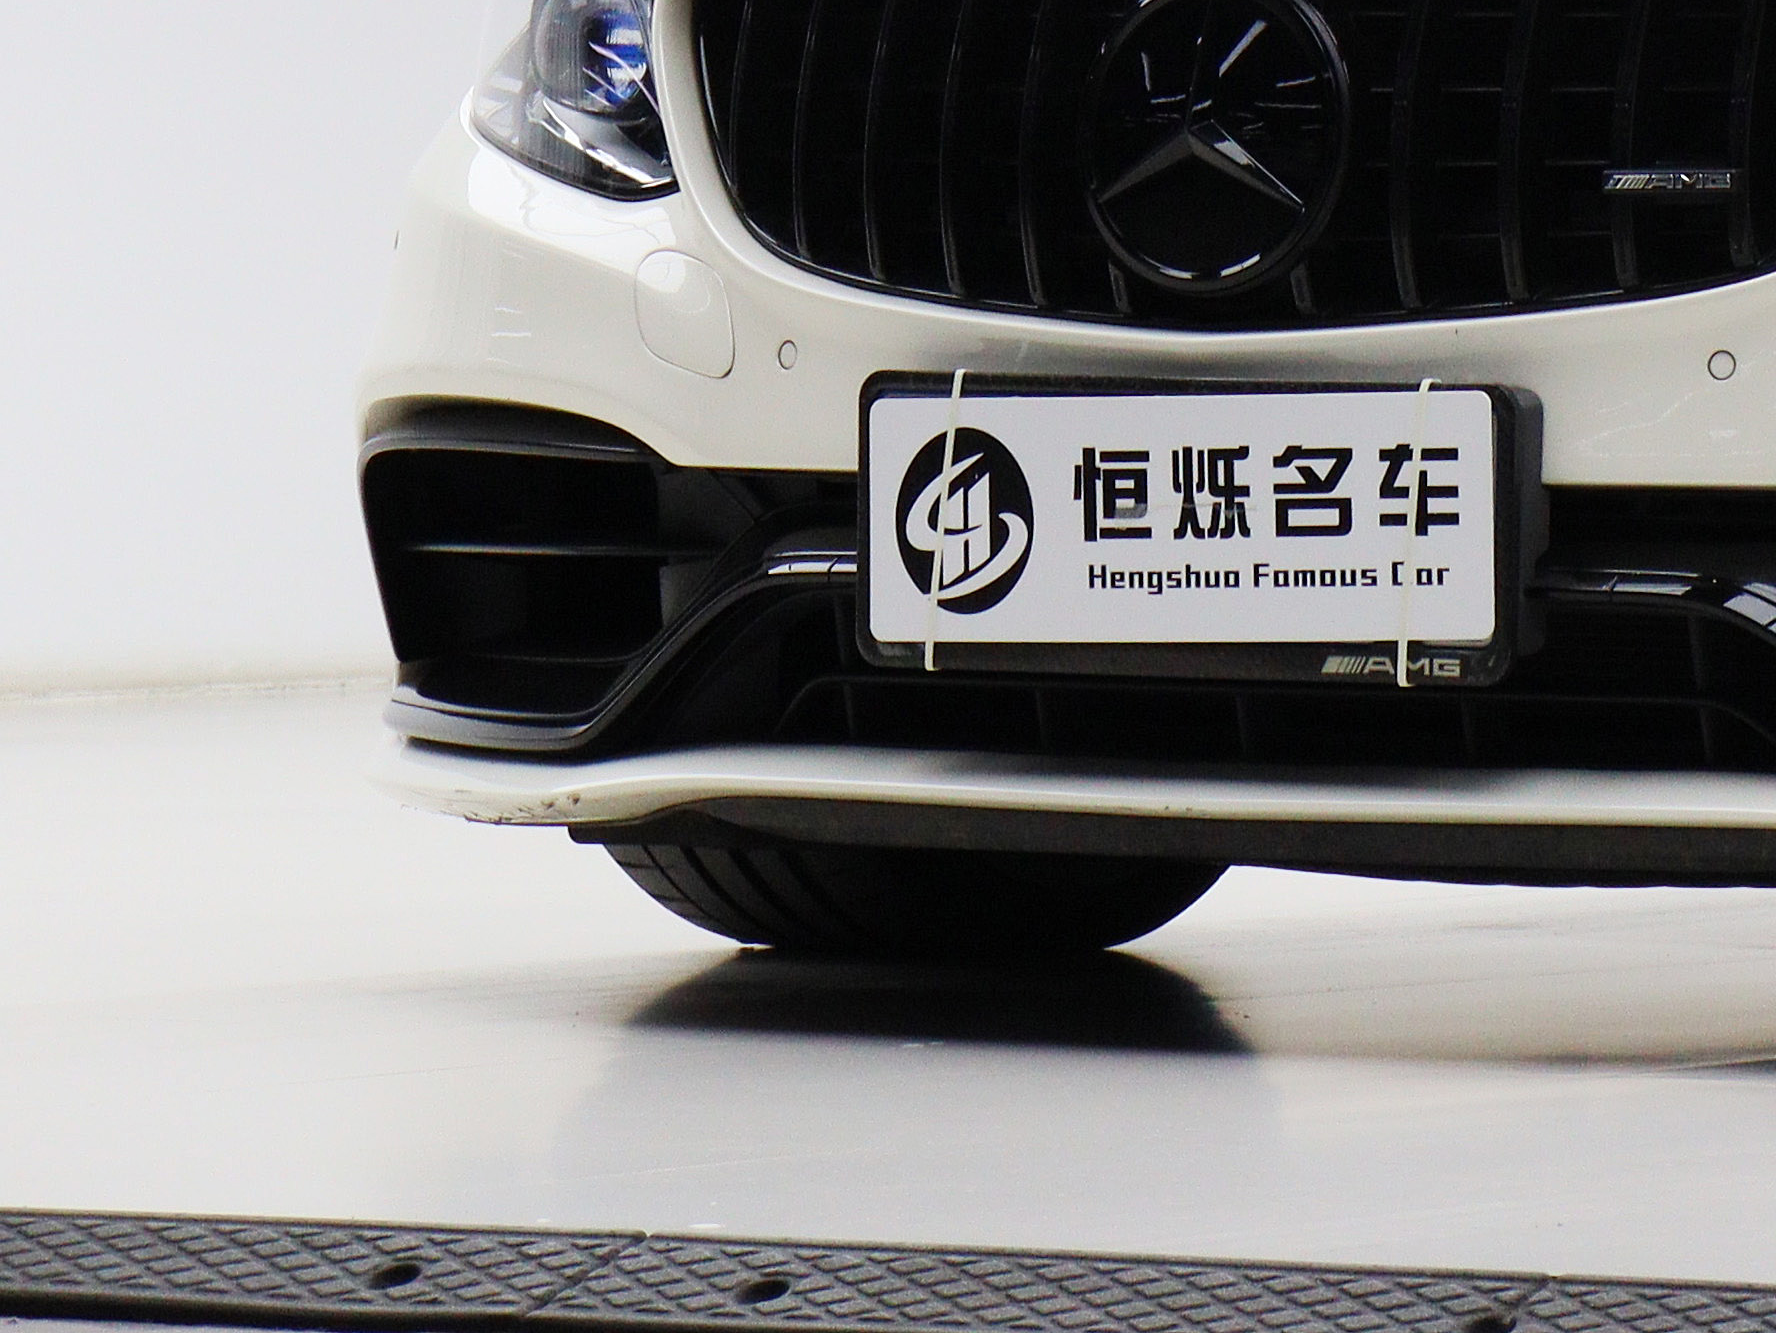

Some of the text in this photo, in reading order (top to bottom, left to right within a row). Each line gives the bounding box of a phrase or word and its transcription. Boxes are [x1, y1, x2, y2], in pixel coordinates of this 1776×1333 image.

[1073, 444, 1460, 542] 恒烁名车
[1088, 561, 1450, 594] Hengshuo Famous Car
